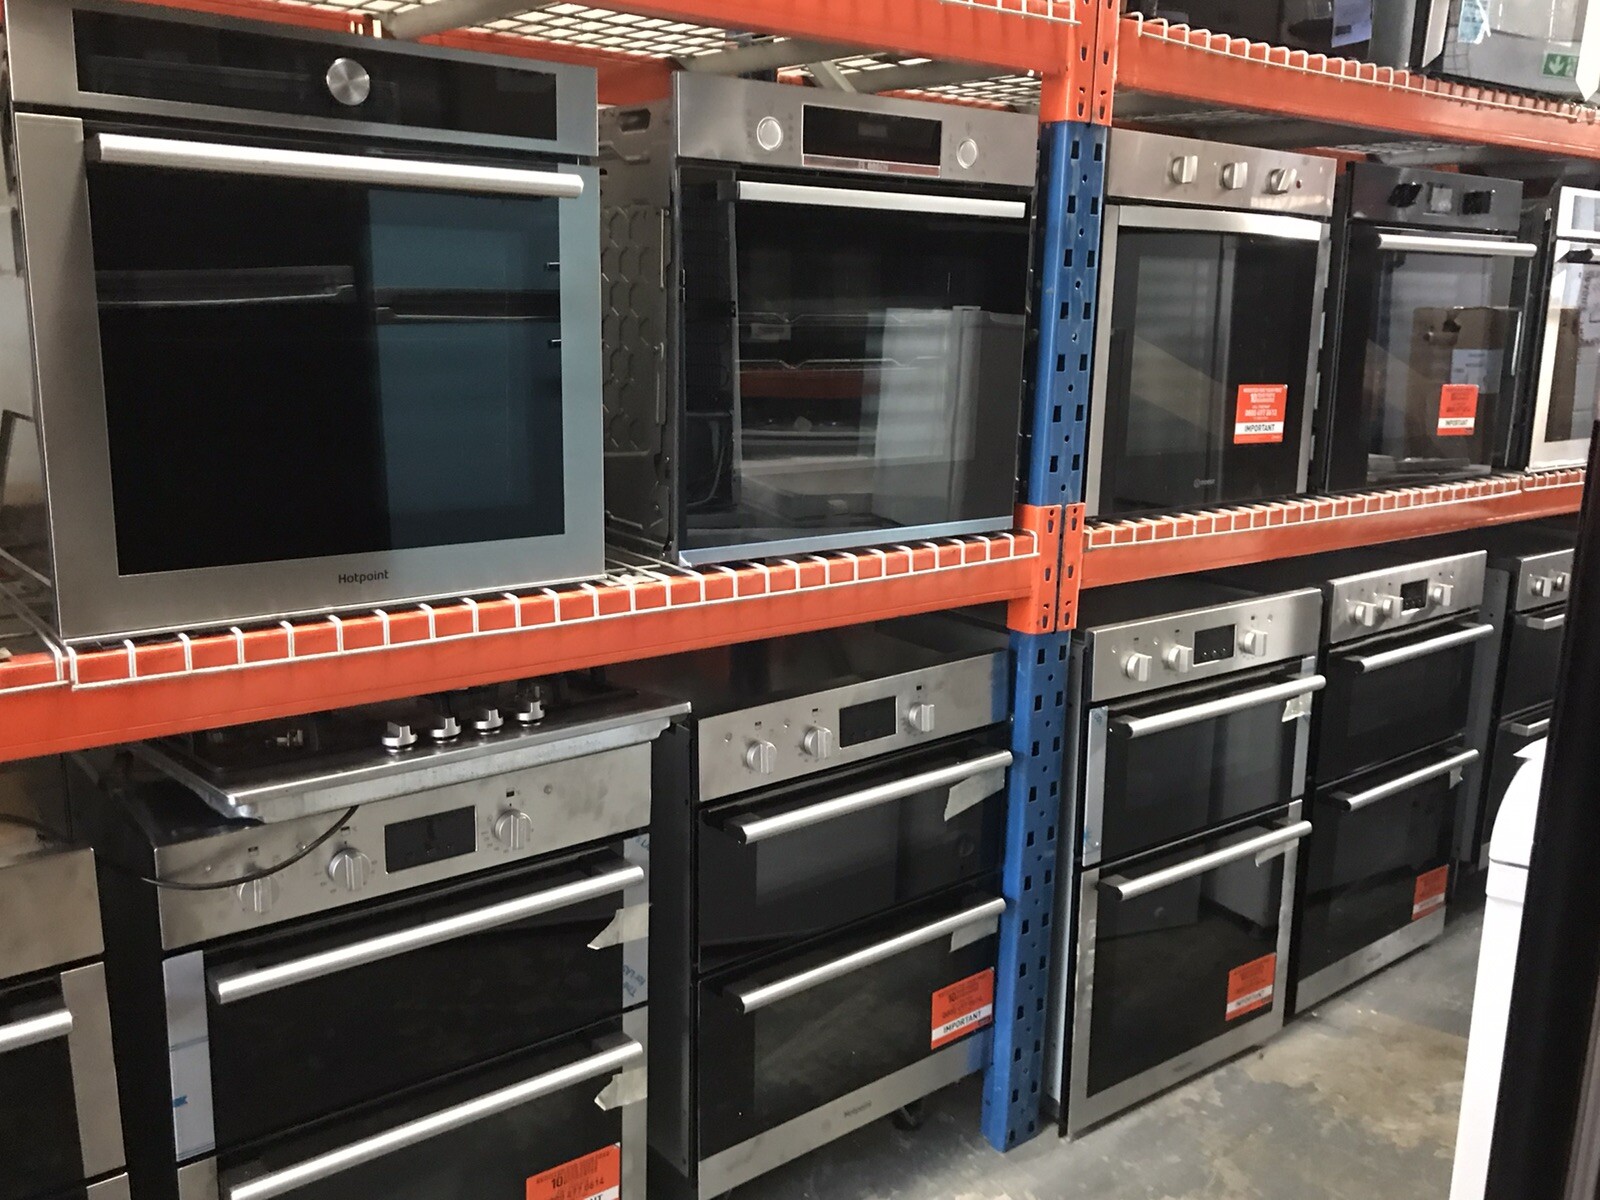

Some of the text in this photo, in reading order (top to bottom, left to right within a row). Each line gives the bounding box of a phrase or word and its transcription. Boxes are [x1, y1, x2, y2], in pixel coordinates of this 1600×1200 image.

[1244, 424, 1275, 432] IMPORTANT
[338, 569, 389, 584] Hotpoint
[943, 1010, 981, 1033] IMPORTANT
